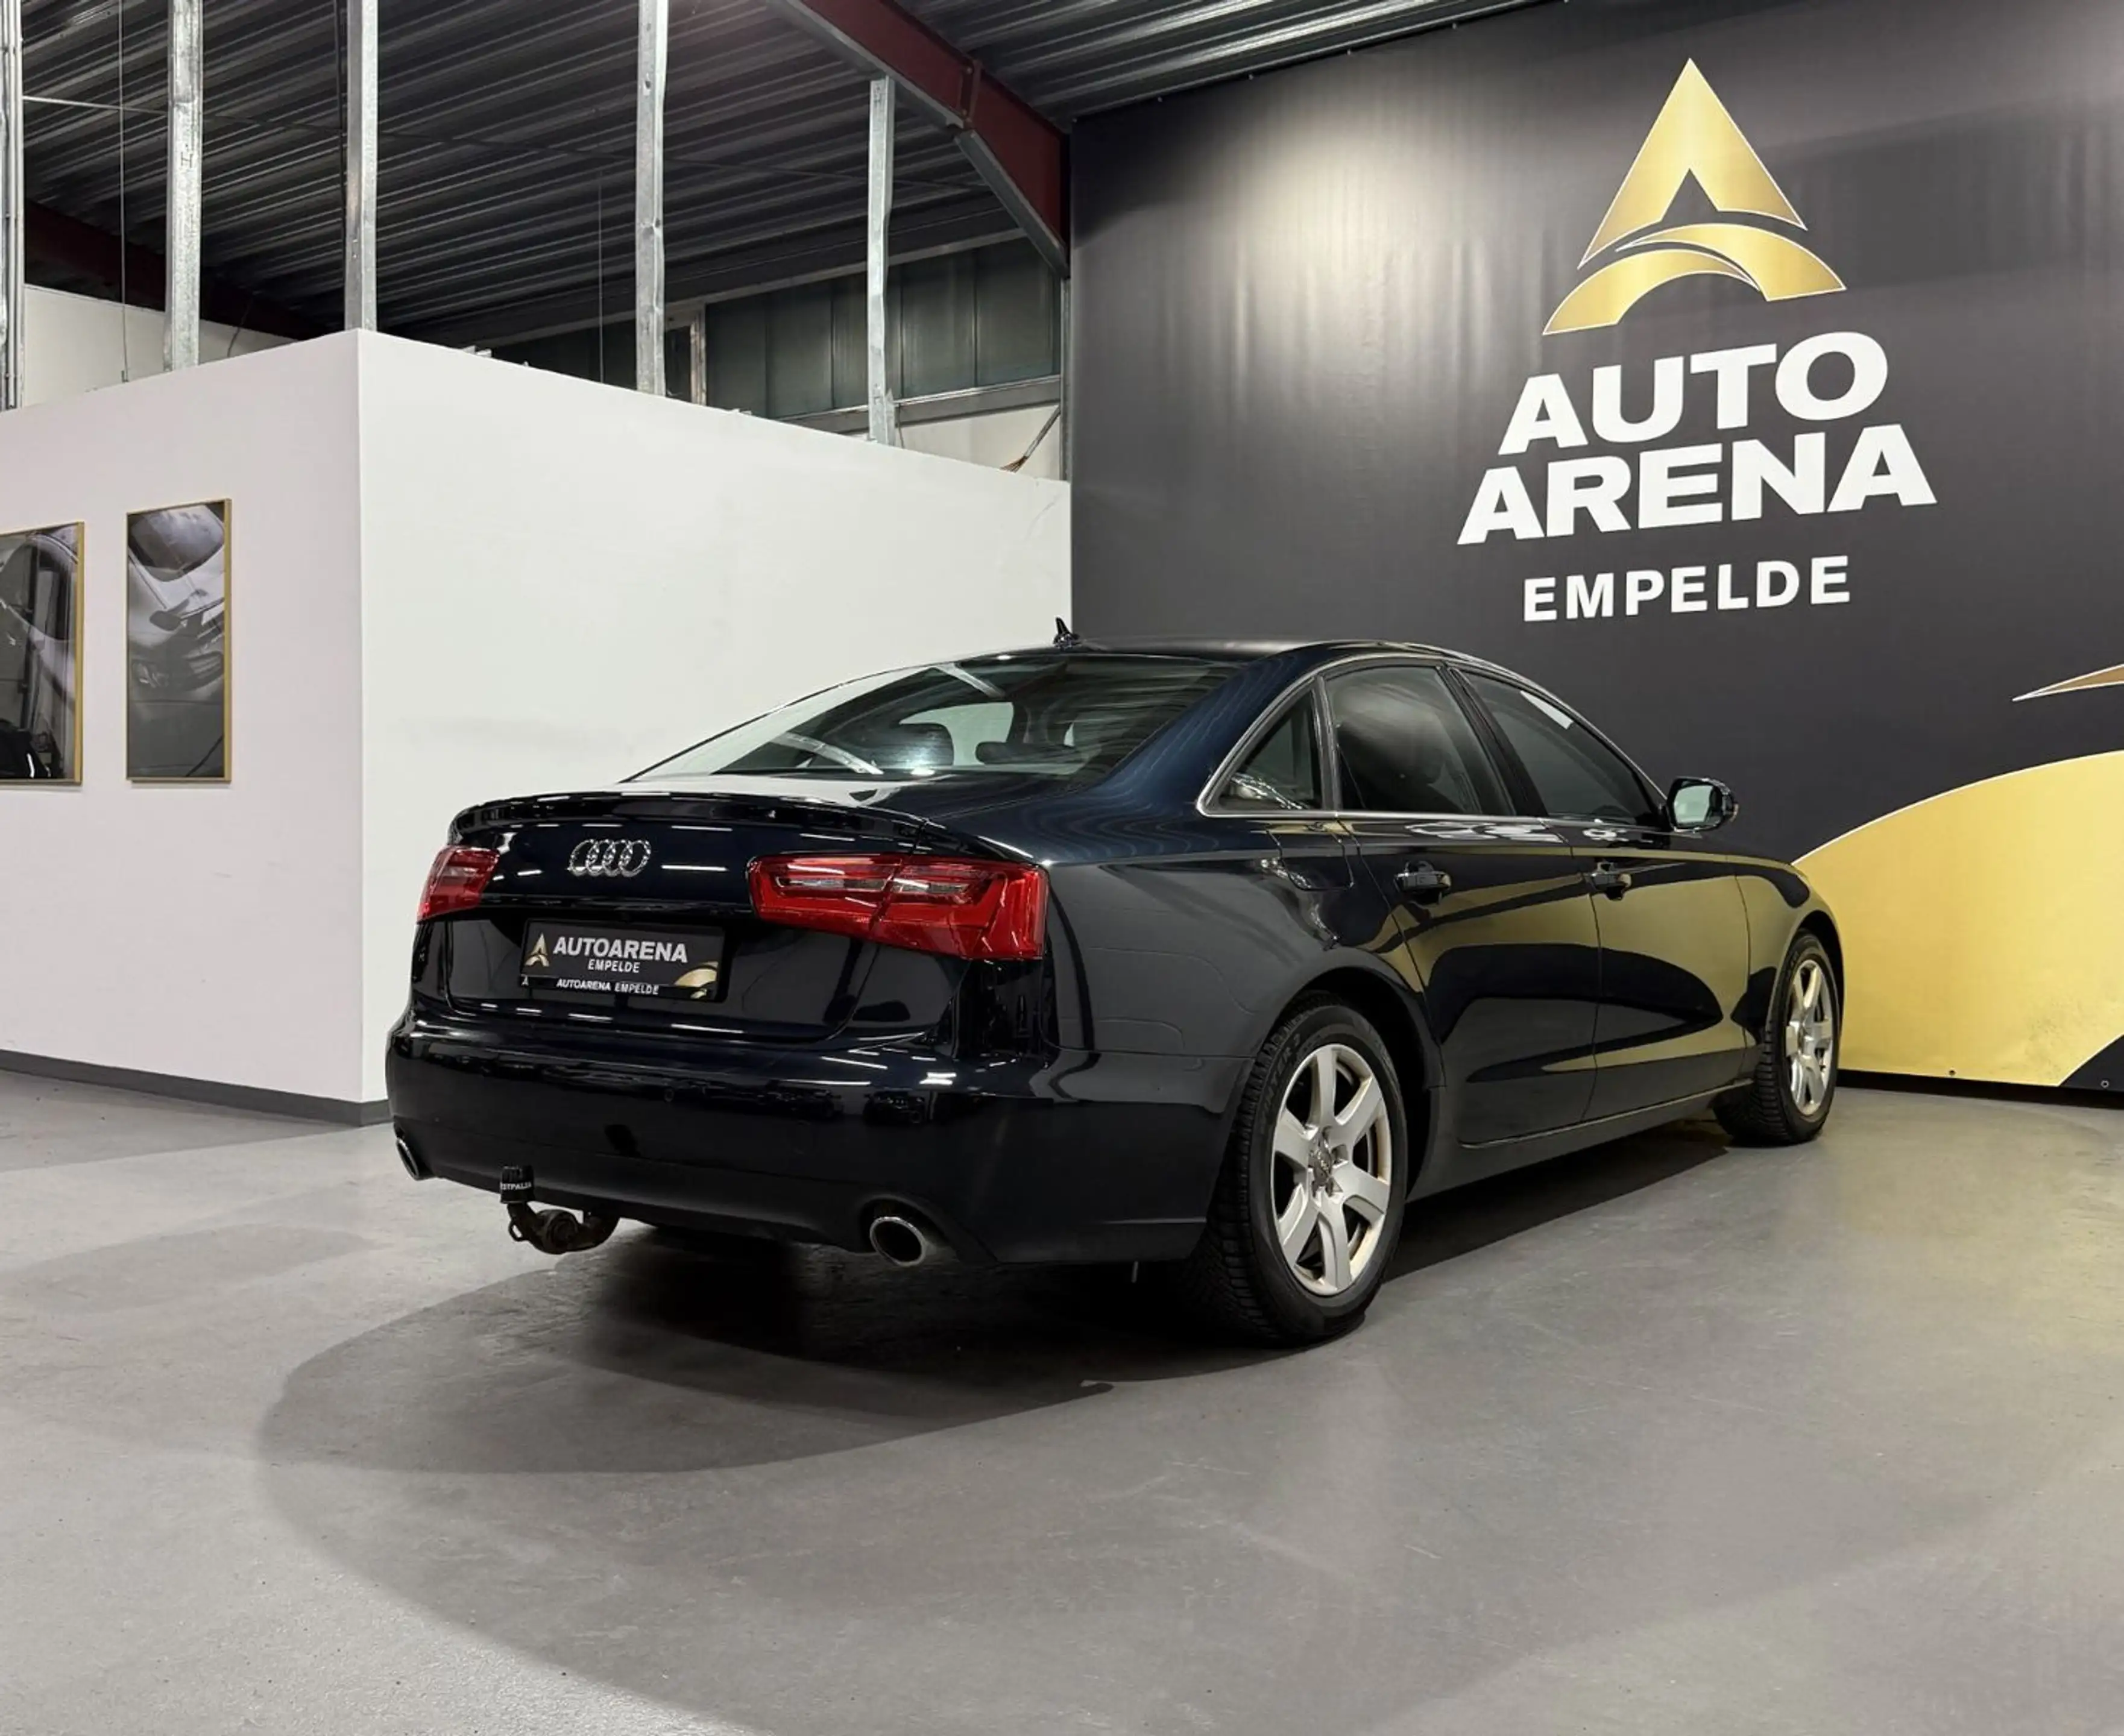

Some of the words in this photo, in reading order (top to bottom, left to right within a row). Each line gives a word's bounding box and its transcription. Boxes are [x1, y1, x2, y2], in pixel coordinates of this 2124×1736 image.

[1498, 332, 1888, 455] AUTO
[1457, 424, 1937, 545] ARENA
[1525, 556, 1850, 621] EMPELDE
[553, 936, 688, 963] AUTOARENA
[588, 958, 640, 973] EMPELDE
[556, 978, 611, 991] AUTOARENA
[614, 983, 660, 995] EMPELDE
